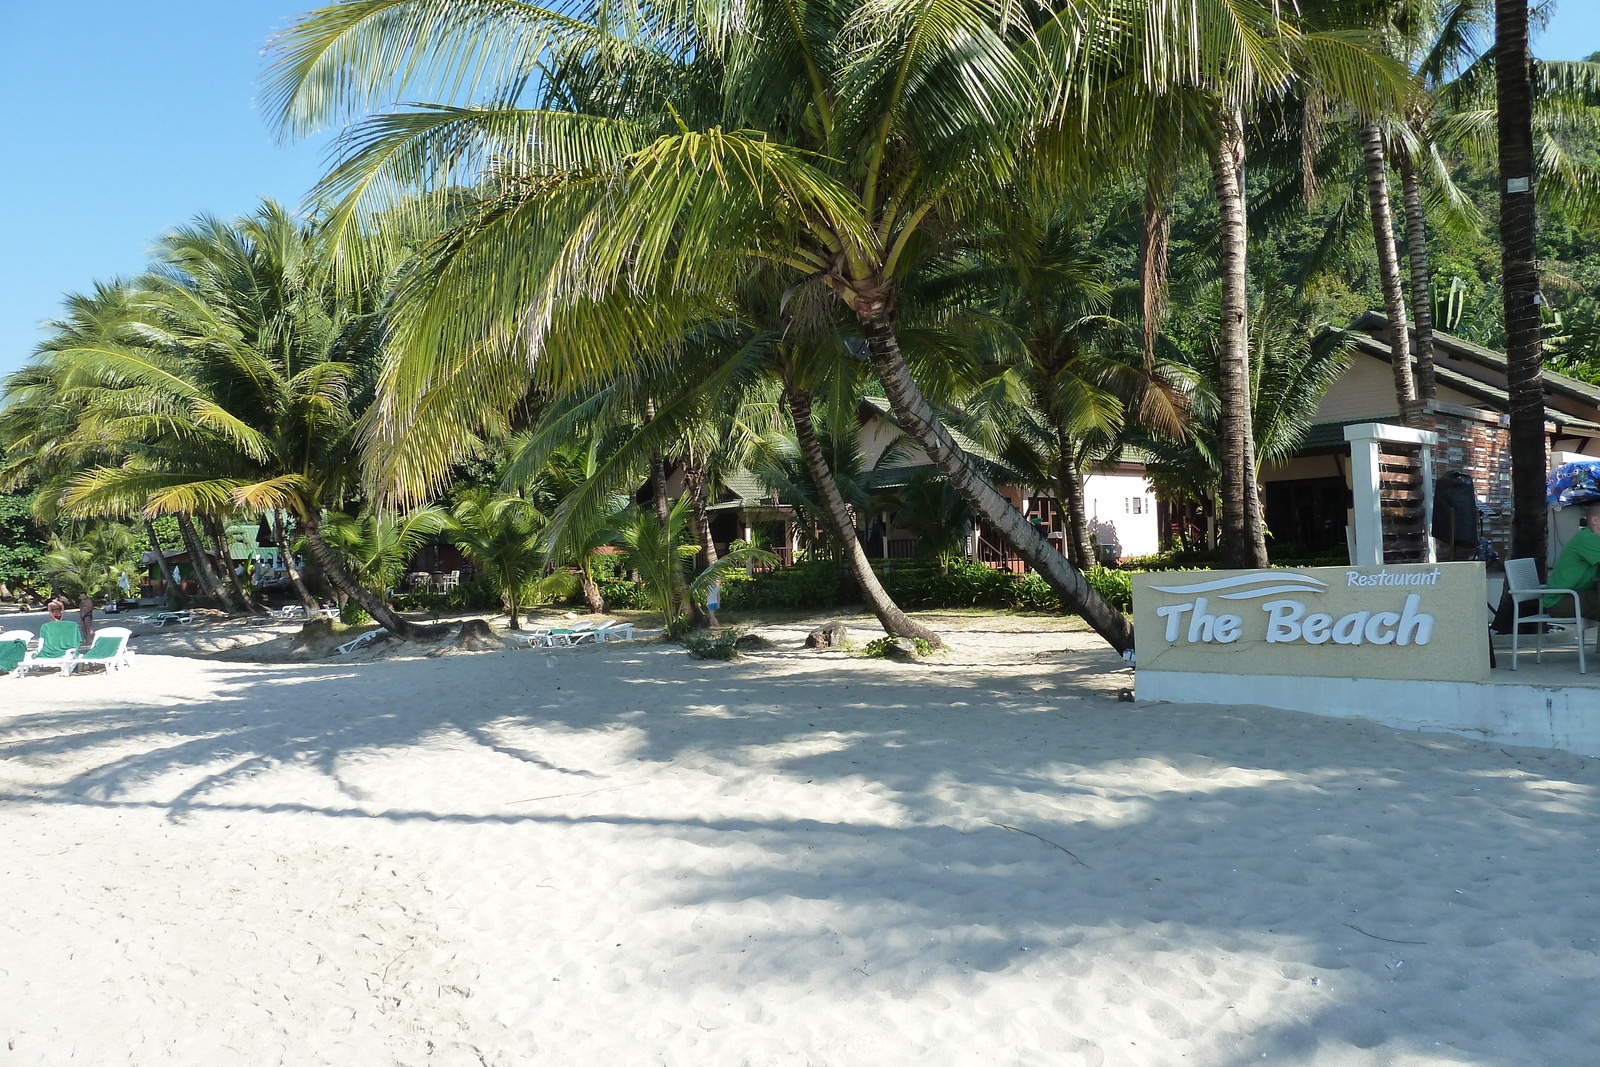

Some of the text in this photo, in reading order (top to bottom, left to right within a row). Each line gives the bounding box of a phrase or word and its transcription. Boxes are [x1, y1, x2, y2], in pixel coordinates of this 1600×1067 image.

[1346, 567, 1440, 586] Restaurant
[1156, 593, 1433, 645] The Beach
